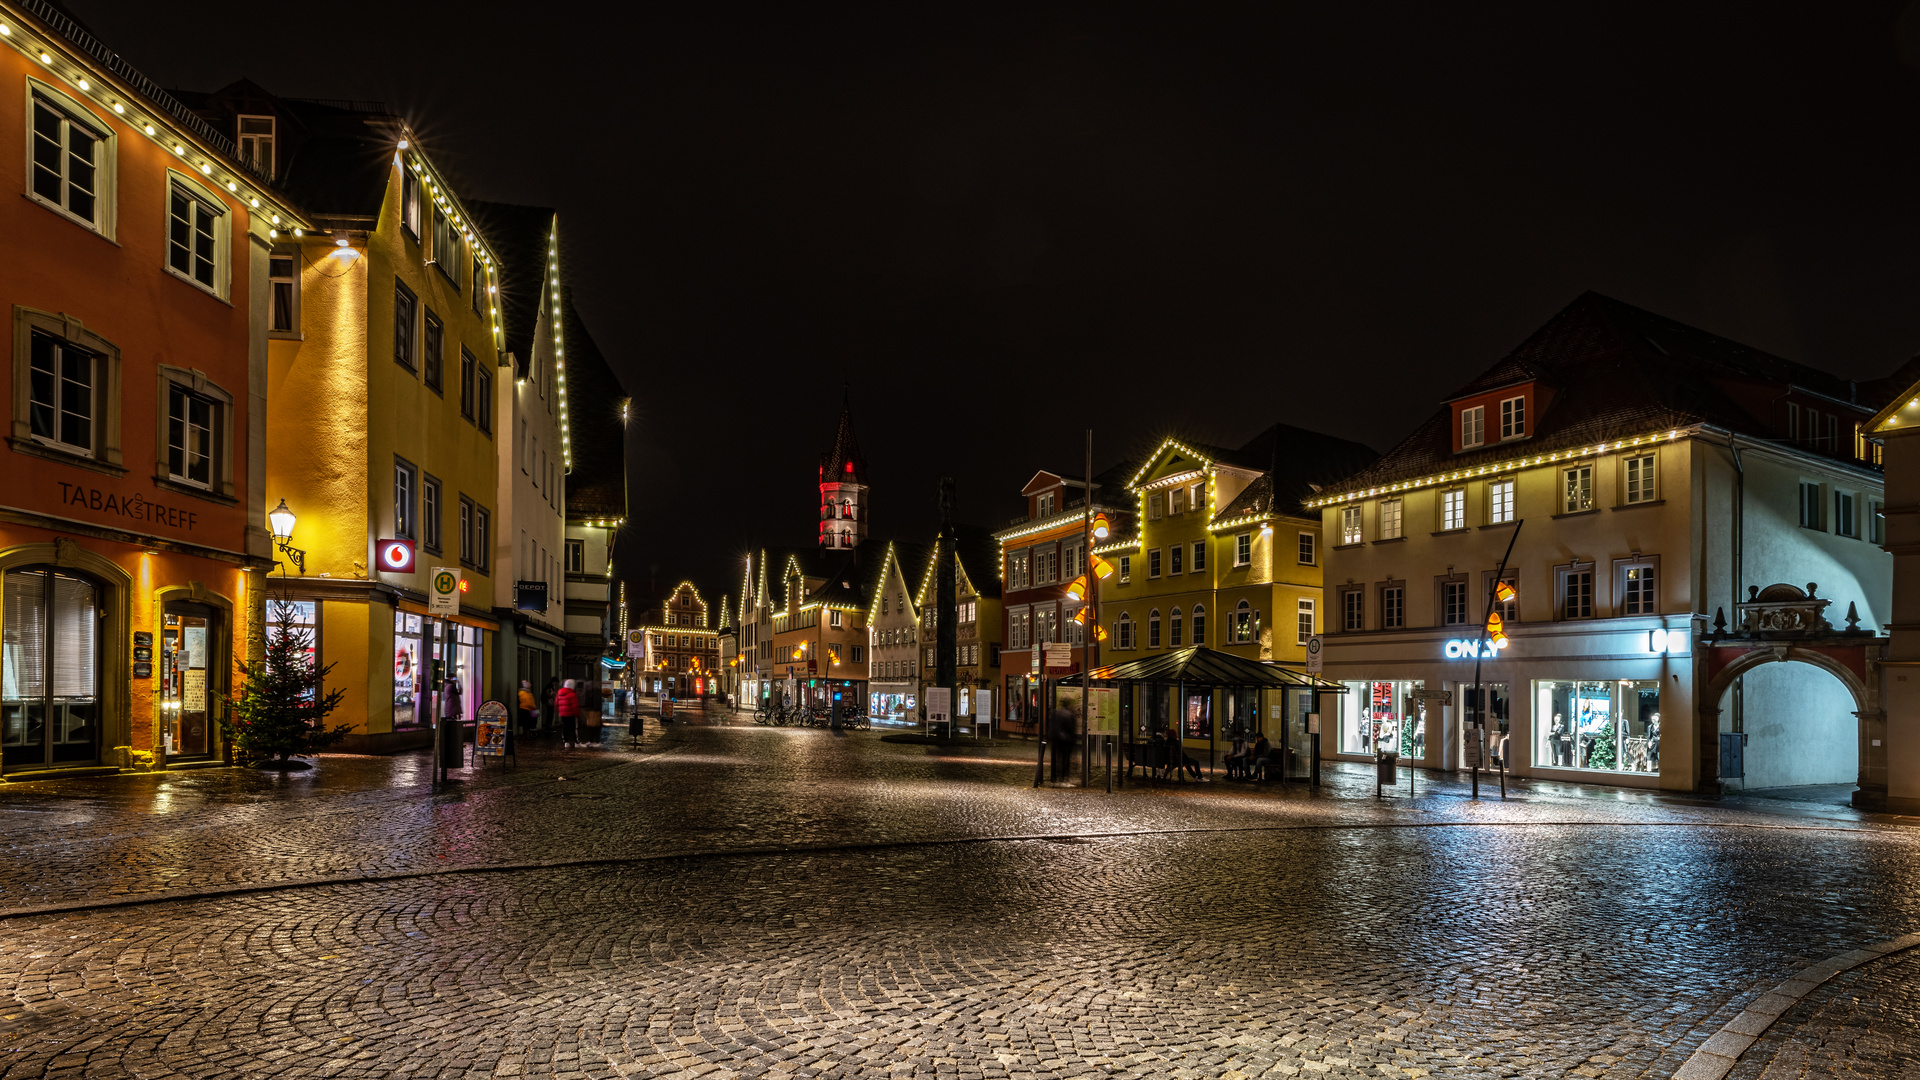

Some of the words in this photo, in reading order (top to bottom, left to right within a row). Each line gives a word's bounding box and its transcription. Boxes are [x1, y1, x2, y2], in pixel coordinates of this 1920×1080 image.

[58, 481, 134, 518] TABAK
[135, 493, 143, 519] UND
[142, 501, 197, 530] TREFF
